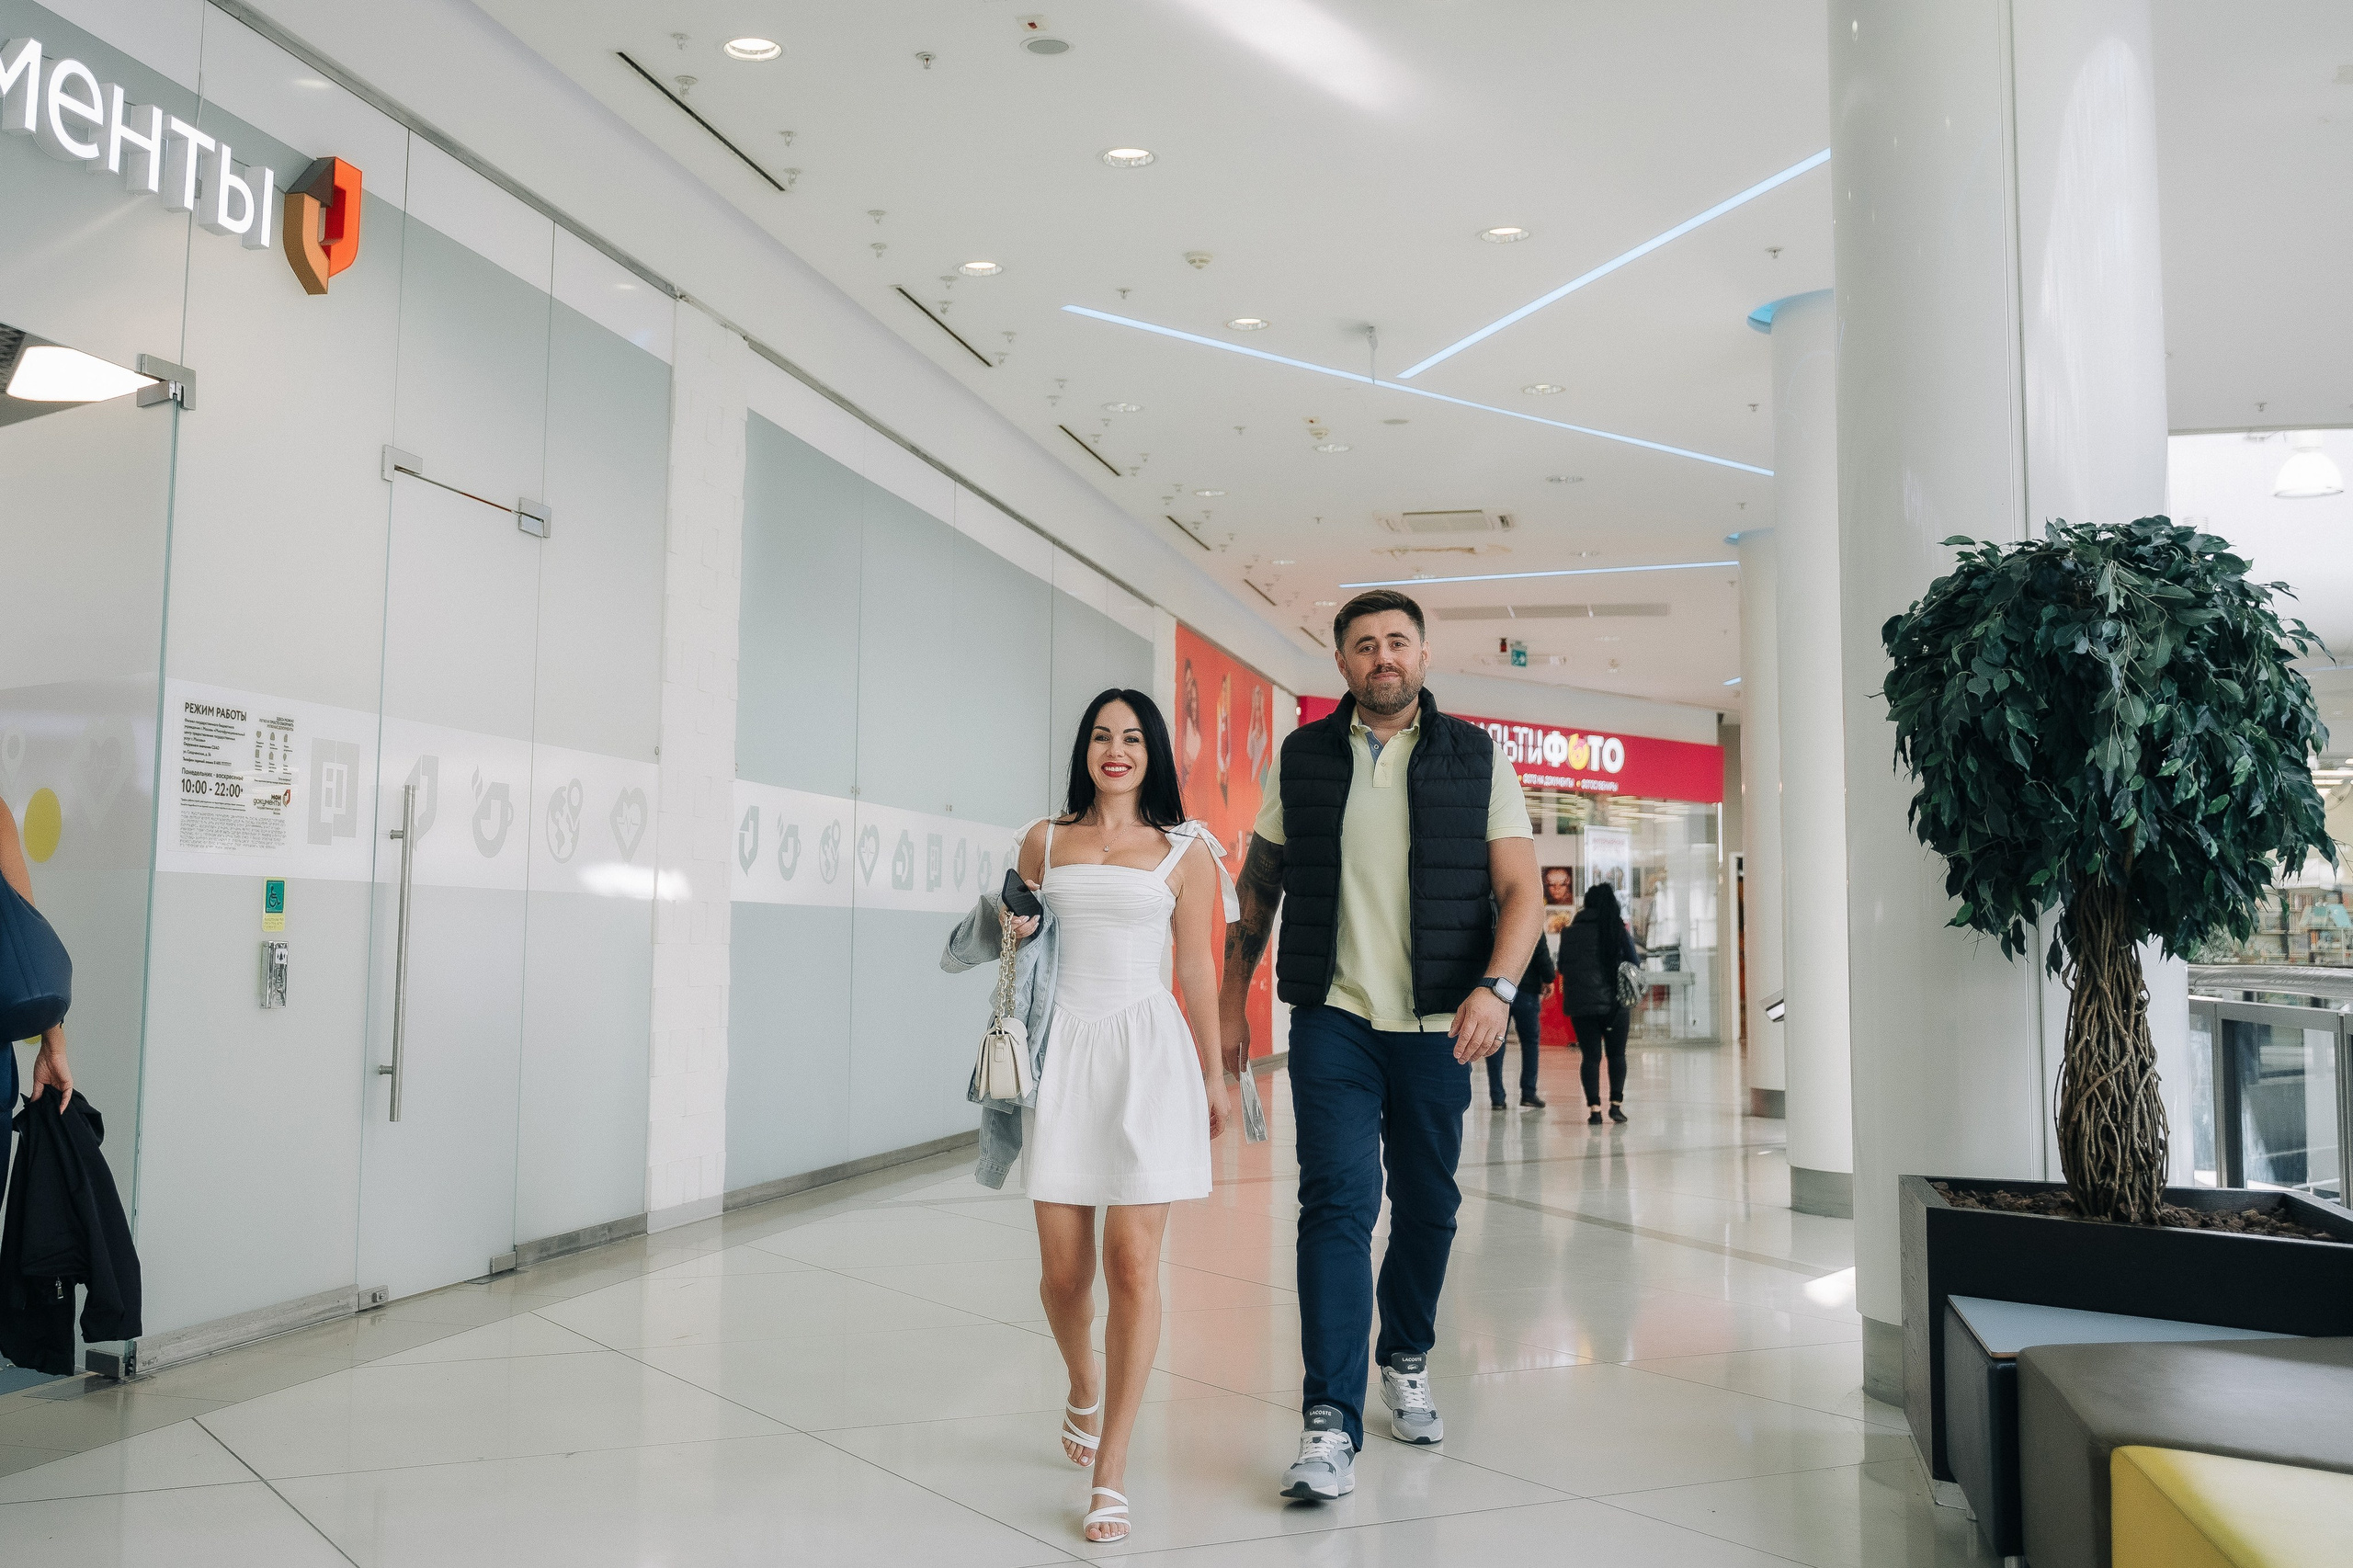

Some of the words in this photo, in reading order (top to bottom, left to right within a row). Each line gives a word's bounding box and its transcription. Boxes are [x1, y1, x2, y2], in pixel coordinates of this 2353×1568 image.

[185, 701, 215, 717] РЕЖИМ
[216, 707, 247, 722] РАБОТЫ
[181, 778, 208, 795] 10:00
